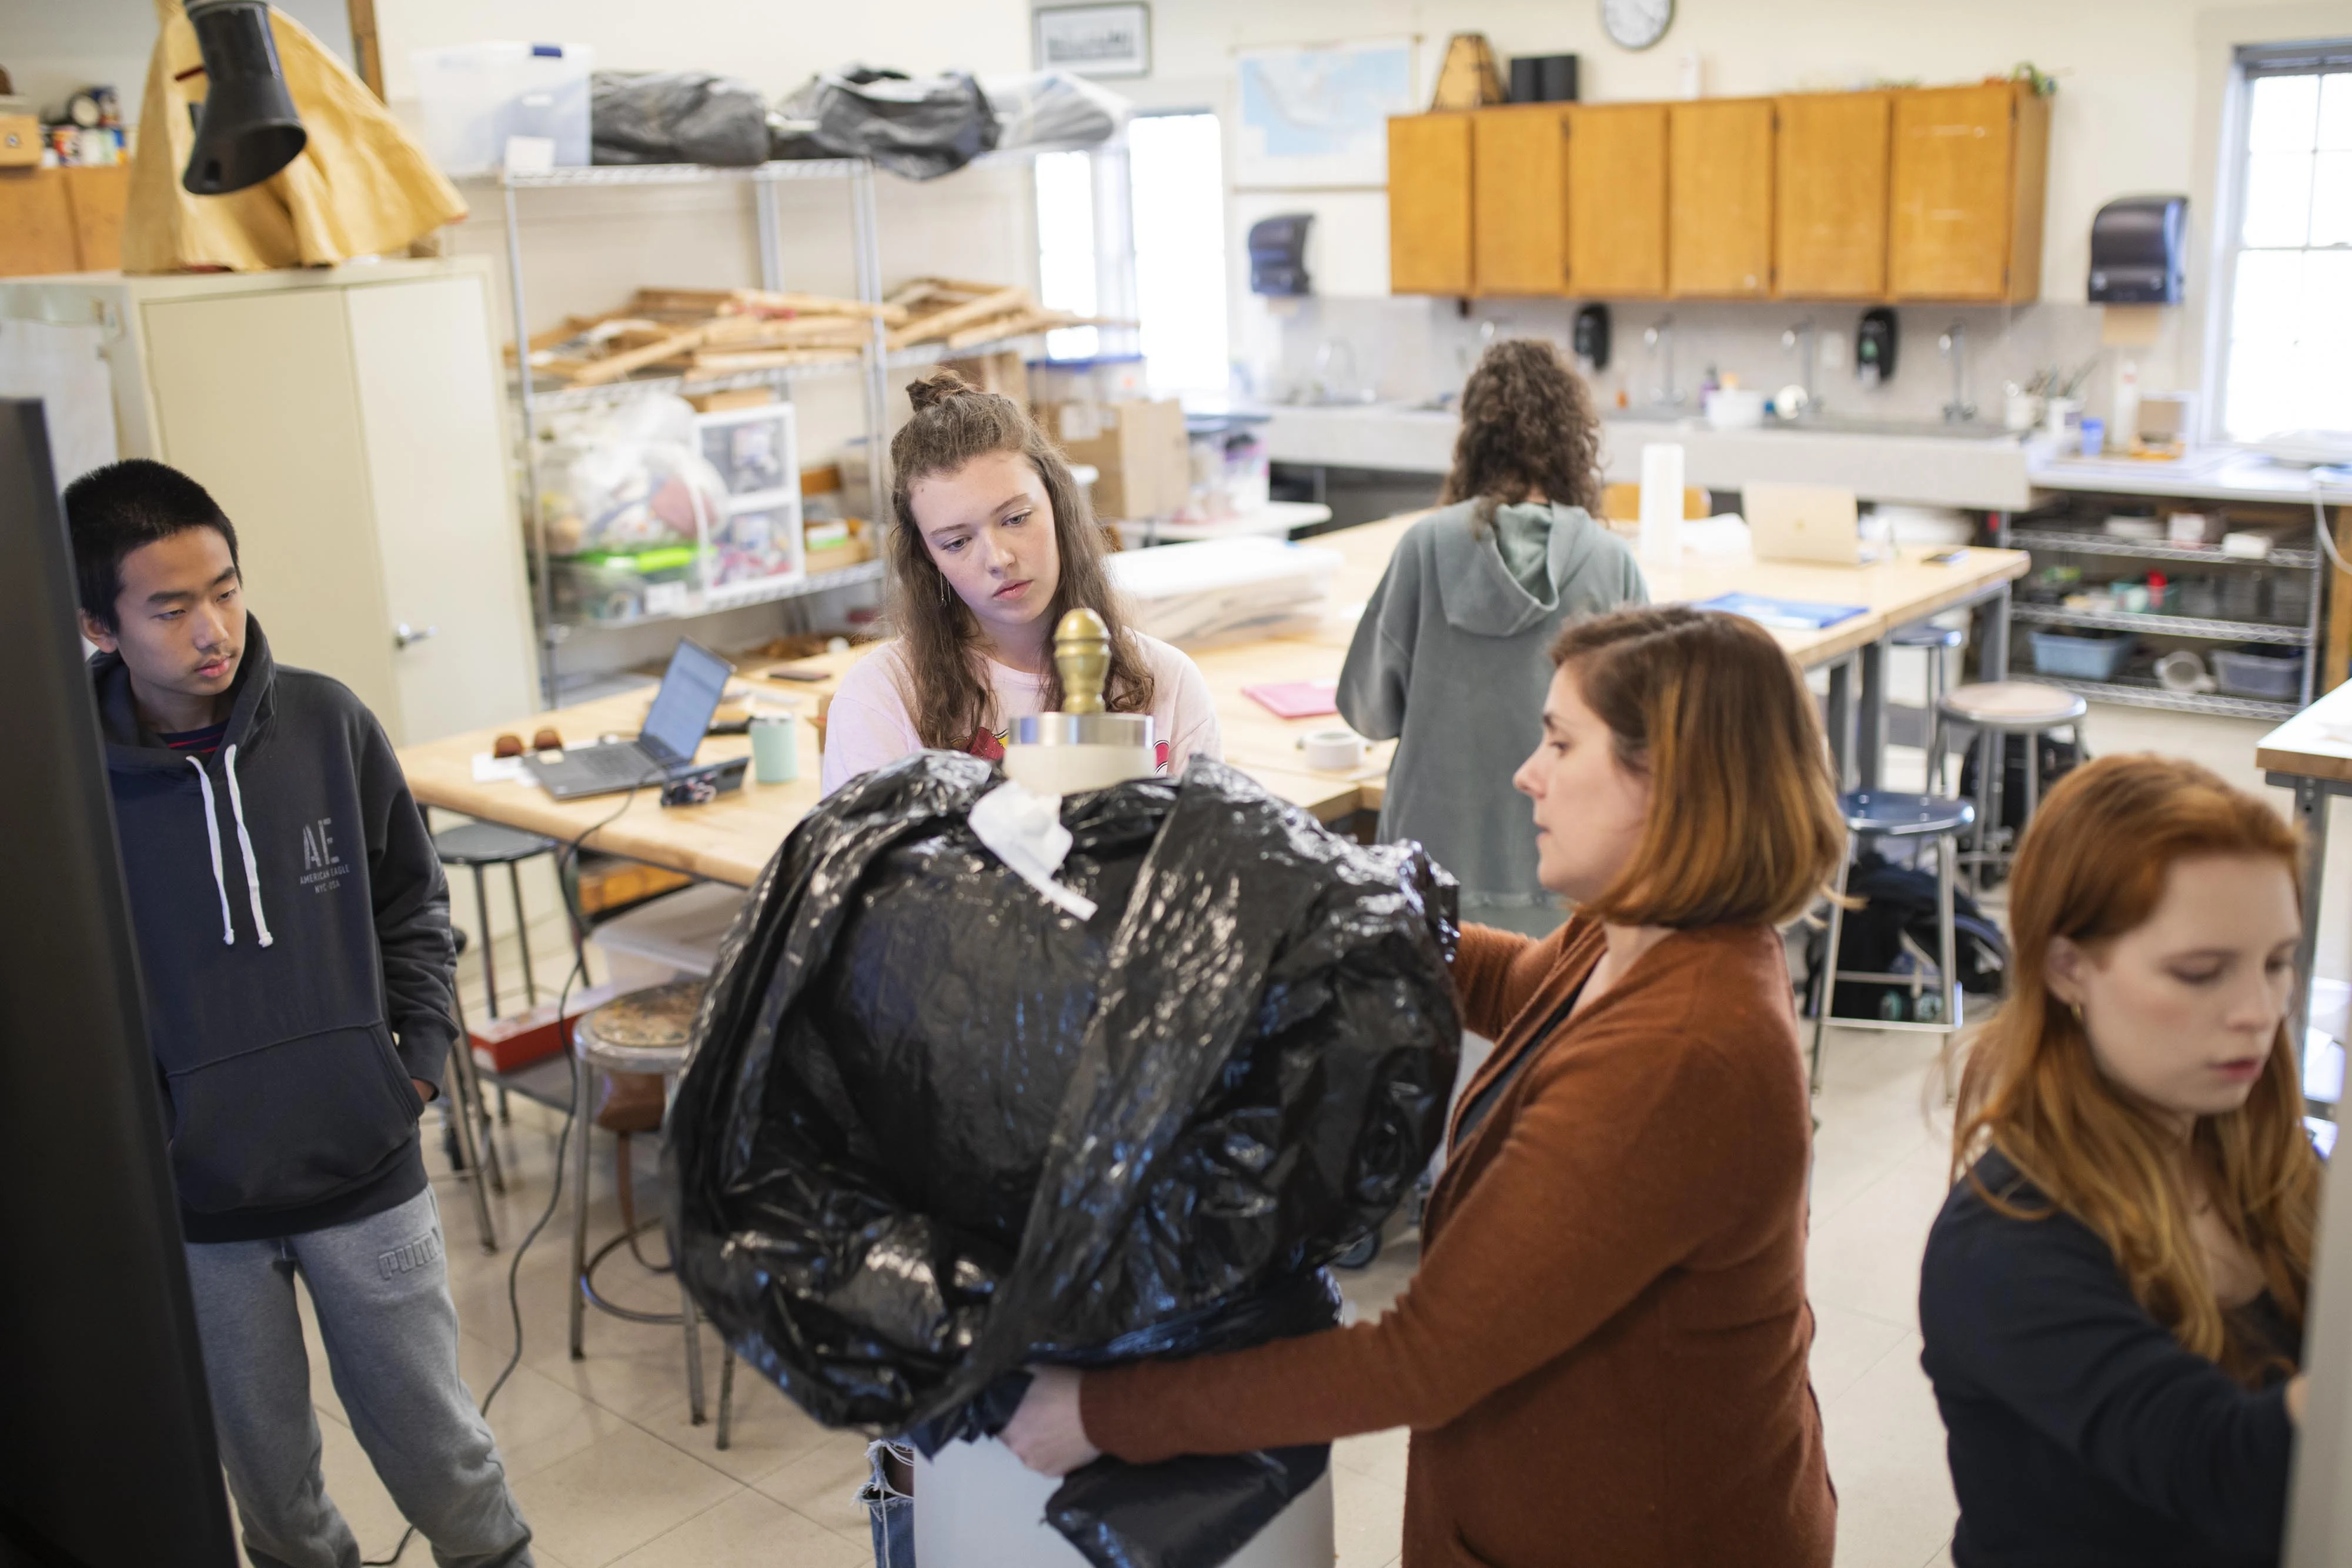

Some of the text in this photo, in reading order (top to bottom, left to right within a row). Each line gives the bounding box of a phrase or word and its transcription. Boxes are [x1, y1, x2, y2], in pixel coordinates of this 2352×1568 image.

[303, 818, 339, 870] AE
[300, 864, 350, 885] AMERICAN EAGLE
[378, 1234, 439, 1281] PUM
